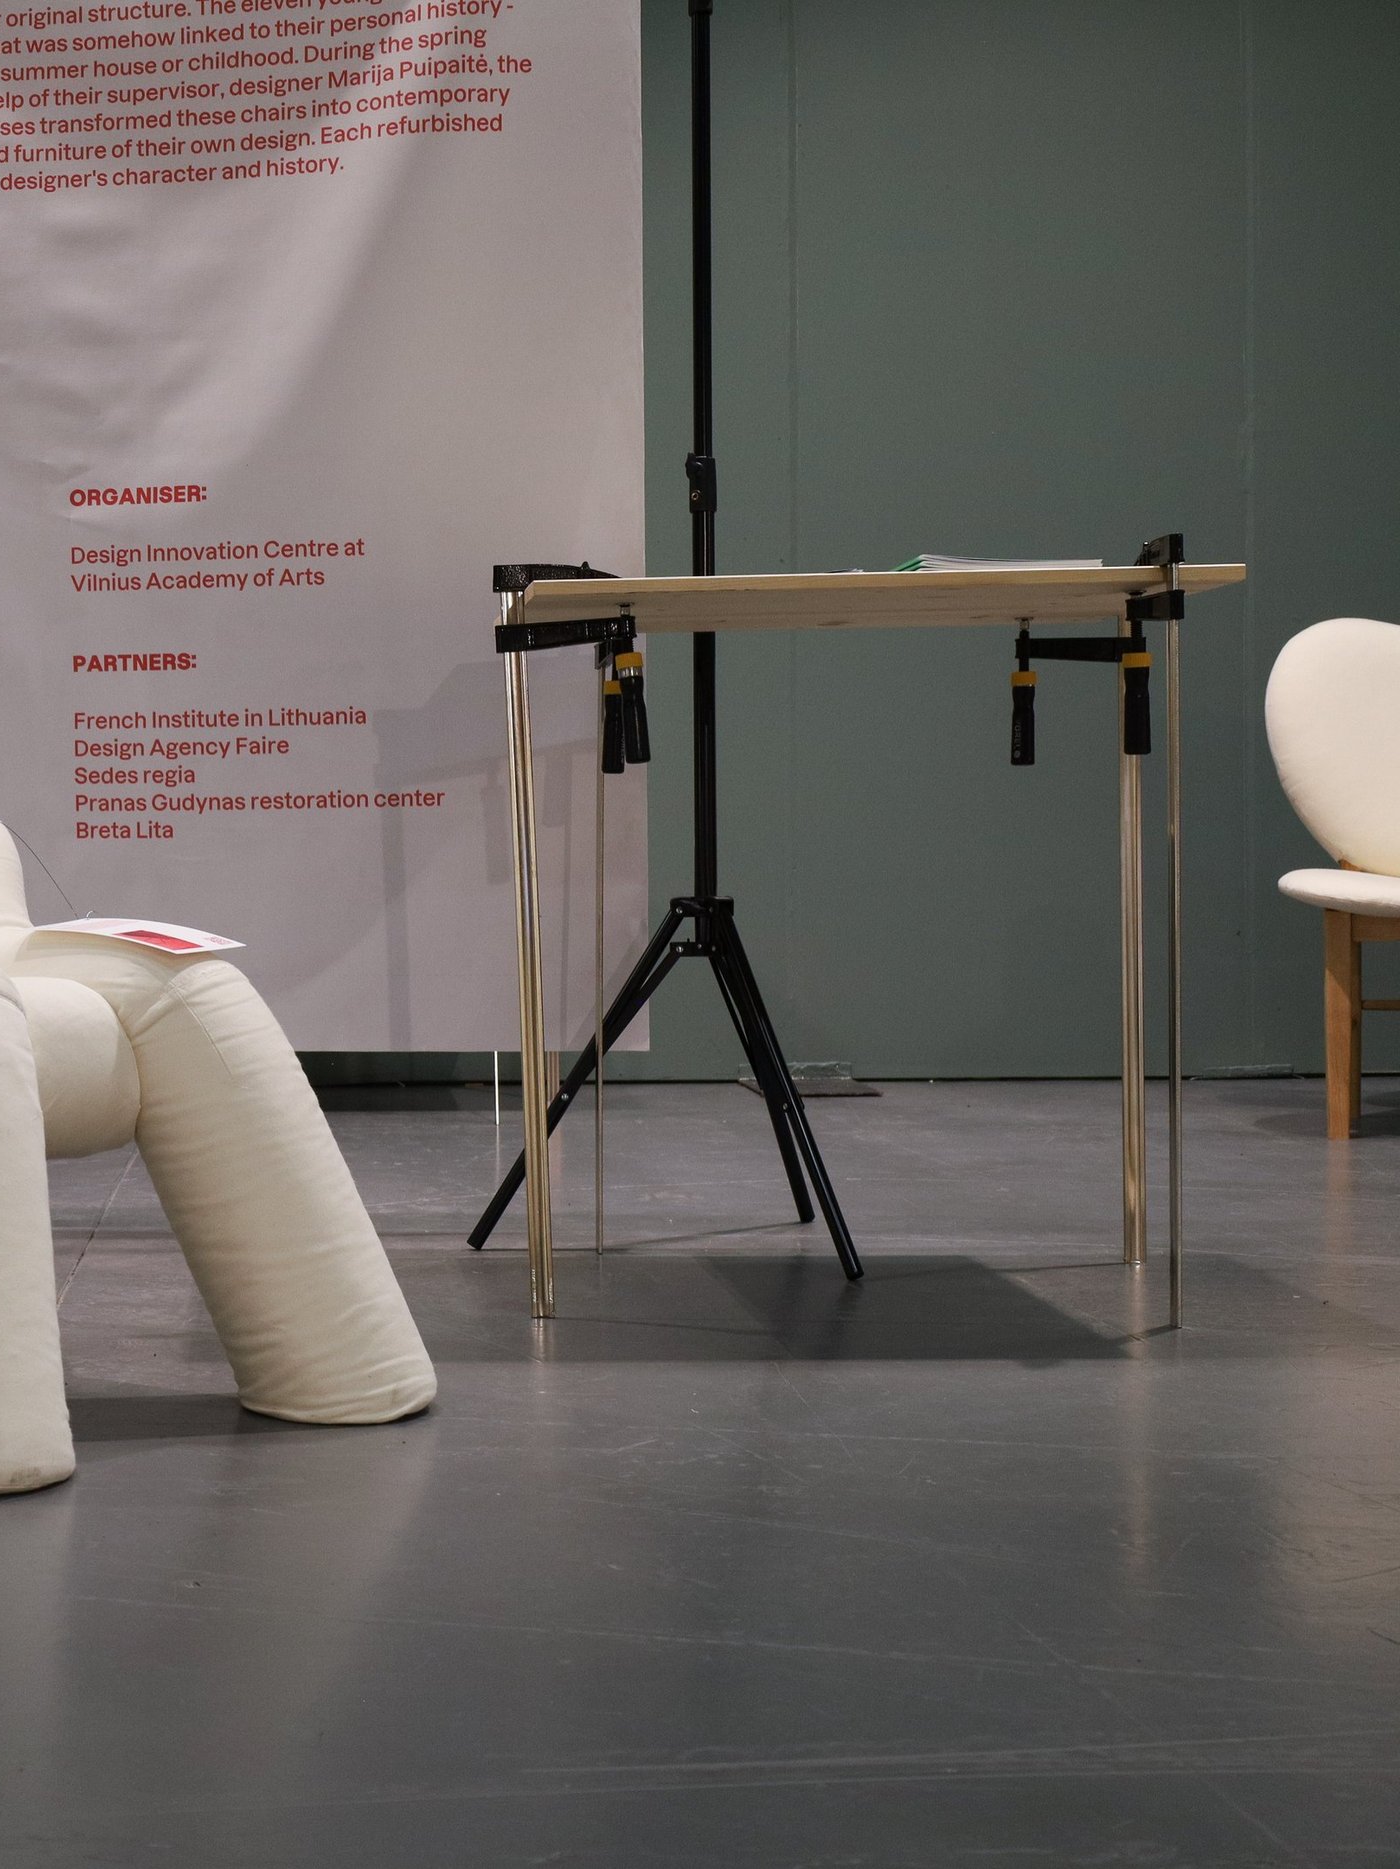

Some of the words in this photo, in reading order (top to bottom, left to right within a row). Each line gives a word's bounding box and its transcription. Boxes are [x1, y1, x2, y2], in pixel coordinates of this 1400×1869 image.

[5, 5, 83, 30] original
[87, 0, 192, 23] structure.
[195, 0, 237, 16] The
[25, 37, 69, 54] was
[72, 30, 176, 52] somehow
[180, 23, 245, 46] linked
[248, 22, 271, 40] to
[274, 15, 326, 38] their
[330, 3, 422, 38] personal
[427, 0, 503, 20] history
[0, 64, 89, 82] summer
[93, 60, 157, 78] house
[161, 58, 185, 74] or
[187, 46, 299, 72] childhood.
[304, 40, 376, 64] During
[378, 36, 414, 55] the
[418, 25, 487, 52] spring
[28, 88, 51, 108] of
[52, 86, 104, 107] their
[106, 80, 225, 107] supervisor,
[229, 74, 324, 98] designer
[328, 63, 394, 89] Marija
[399, 53, 494, 80] Puipaitė,
[496, 54, 533, 74] the
[39, 109, 172, 135] transformed
[175, 108, 237, 127] these
[240, 101, 307, 124] chairs
[311, 98, 352, 118] into
[356, 87, 511, 113] contemporary
[13, 142, 107, 163] furniture
[111, 138, 133, 159] of
[135, 136, 187, 158] their
[190, 137, 236, 155] own
[240, 129, 316, 152] design.
[320, 122, 372, 145] Each
[377, 112, 503, 138] refurbished
[0, 169, 109, 193] designer's
[112, 164, 218, 186] character
[221, 160, 261, 181] and
[266, 156, 344, 177] history.
[69, 484, 208, 507] ORGANISER:
[70, 544, 142, 568] Design
[146, 540, 259, 563] Innovation
[263, 539, 339, 559] Centre
[343, 537, 366, 557] at
[70, 572, 142, 593] Vilnius
[145, 570, 249, 592] Academy
[252, 567, 276, 588] of
[278, 567, 325, 587] Arts
[72, 652, 197, 673] PARTNERS:
[74, 711, 147, 730] French
[152, 708, 240, 729] Institute
[244, 708, 263, 727] in
[268, 705, 367, 727] Lithuania
[74, 738, 145, 761] Design
[149, 738, 231, 761] Agency
[235, 735, 290, 755] Faire
[74, 766, 139, 785] Sedes
[143, 764, 196, 788] regia
[75, 794, 148, 812] Pranas
[151, 793, 246, 815] Gudynas
[250, 789, 369, 811] restoration
[373, 789, 446, 808] center
[76, 821, 131, 840] Breta
[136, 819, 174, 840] Lita
